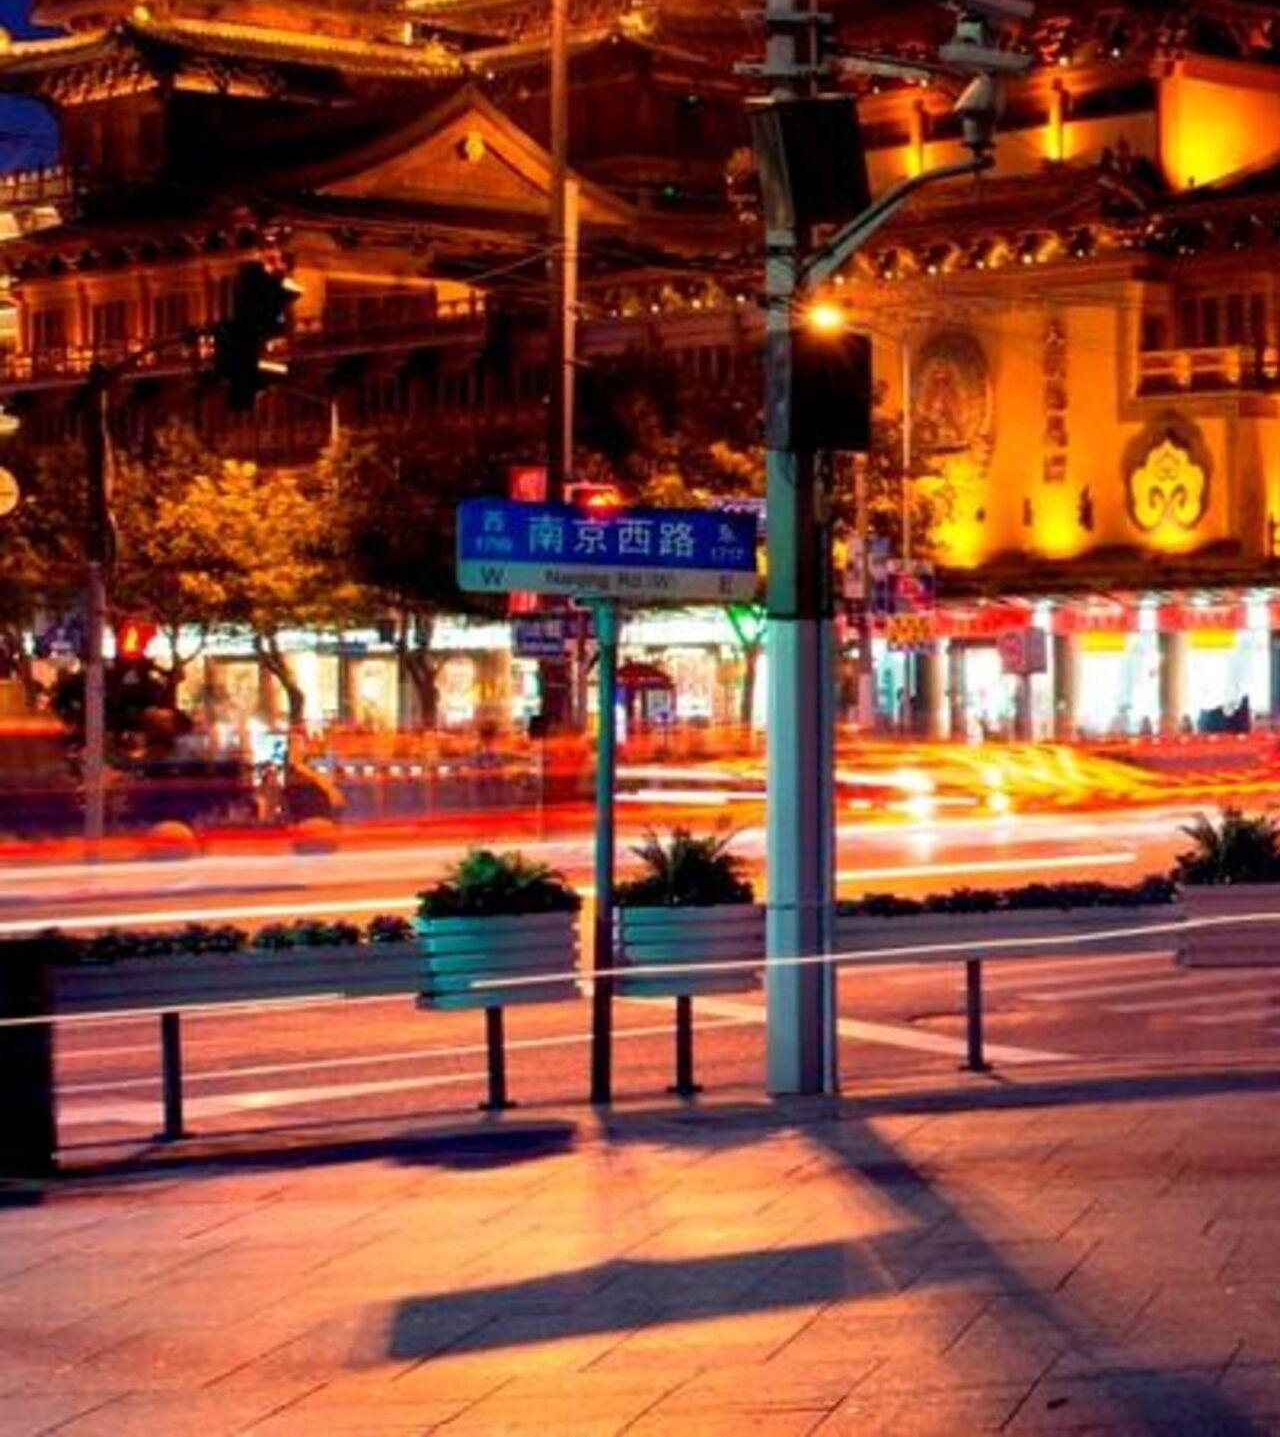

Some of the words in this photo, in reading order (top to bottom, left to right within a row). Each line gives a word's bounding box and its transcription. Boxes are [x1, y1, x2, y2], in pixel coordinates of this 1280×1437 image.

[528, 515, 695, 558] 南京西路
[481, 567, 504, 586] W
